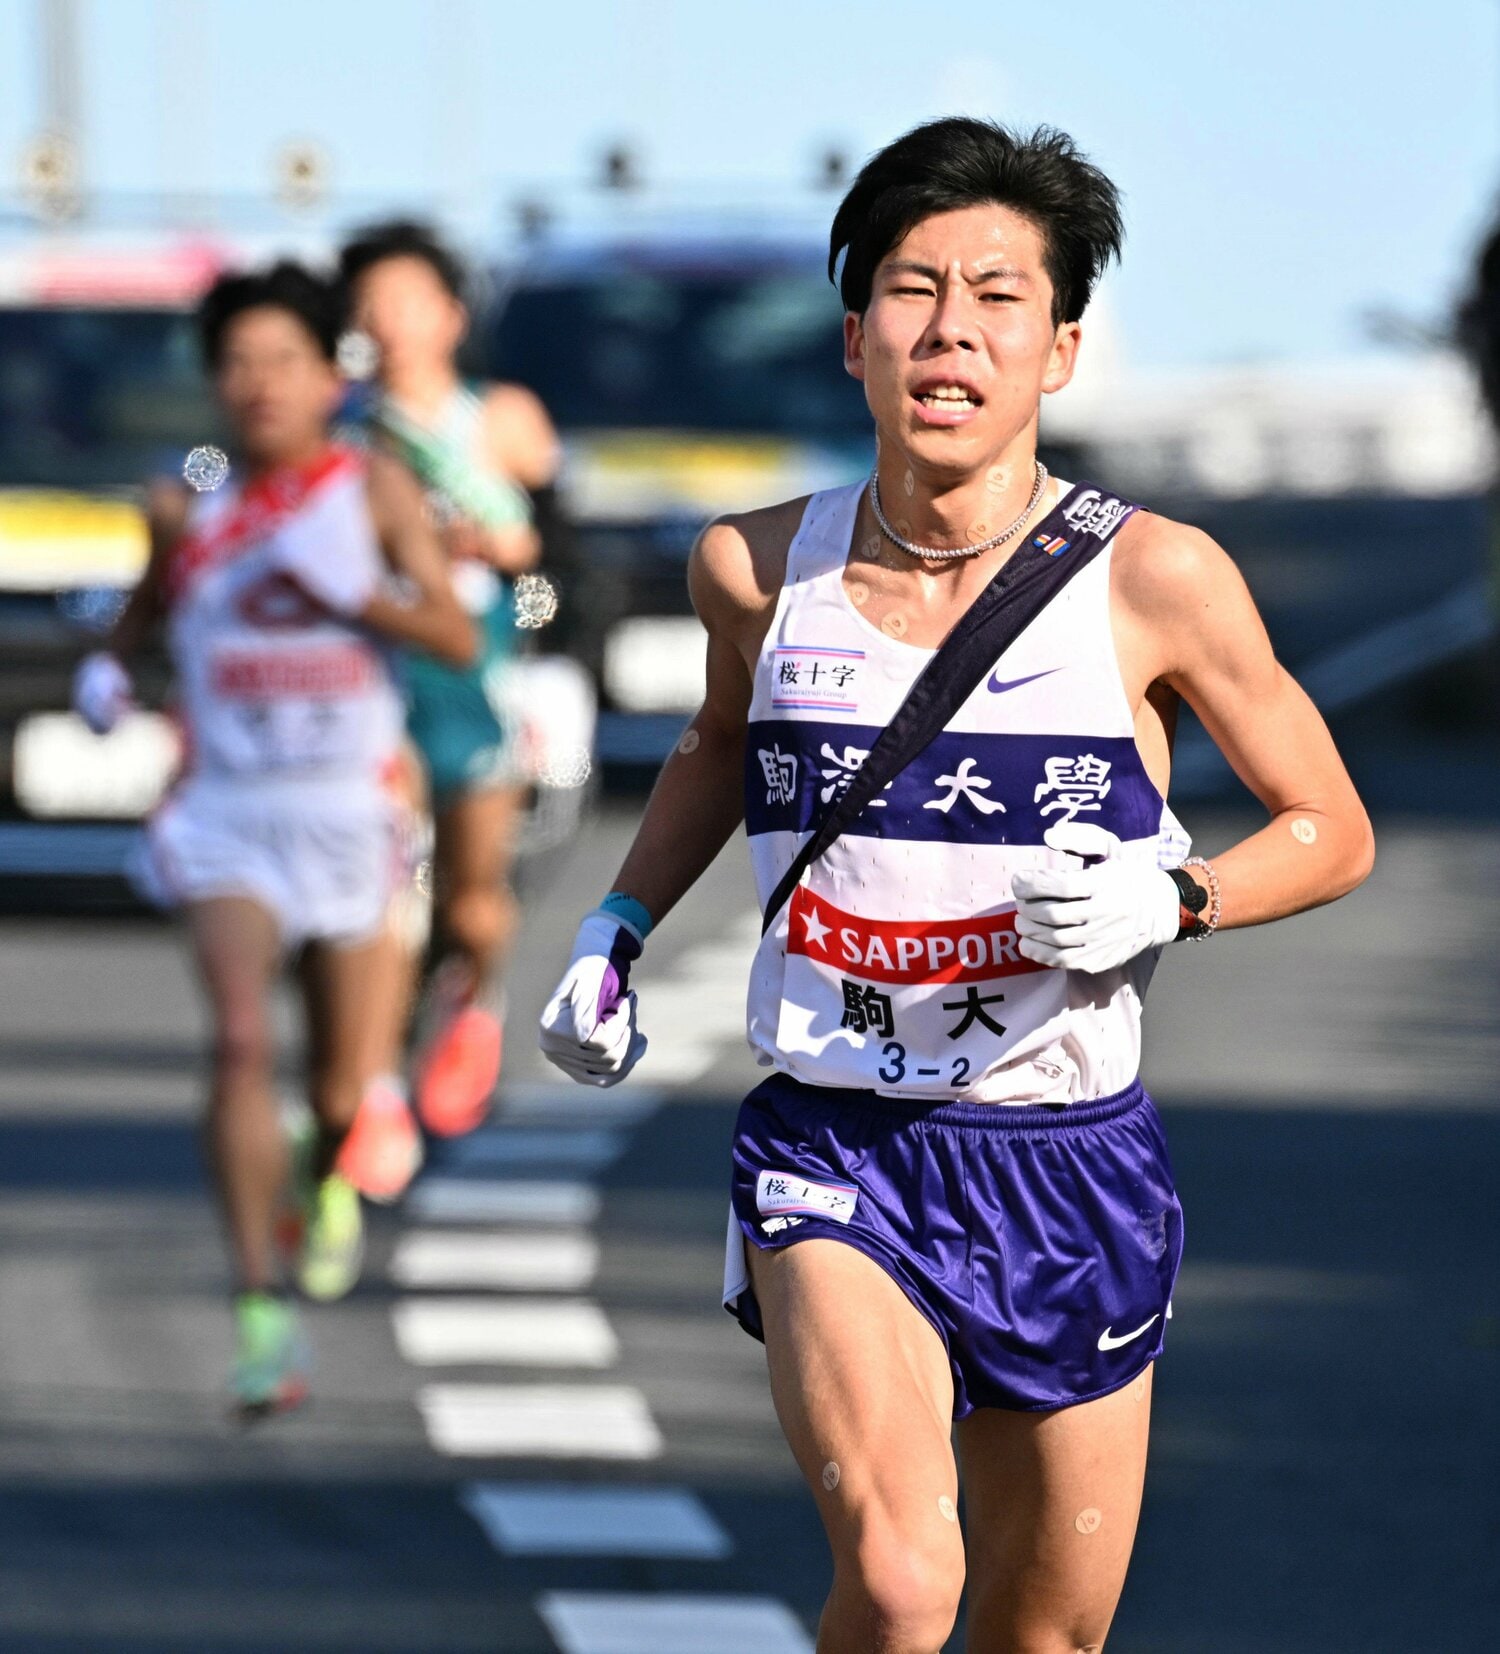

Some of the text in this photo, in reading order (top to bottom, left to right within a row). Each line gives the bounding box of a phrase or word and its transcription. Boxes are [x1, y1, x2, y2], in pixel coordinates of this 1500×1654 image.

[779, 661, 856, 687] 桜十字
[823, 689, 848, 699] Group
[840, 927, 1022, 972] SAPPOR
